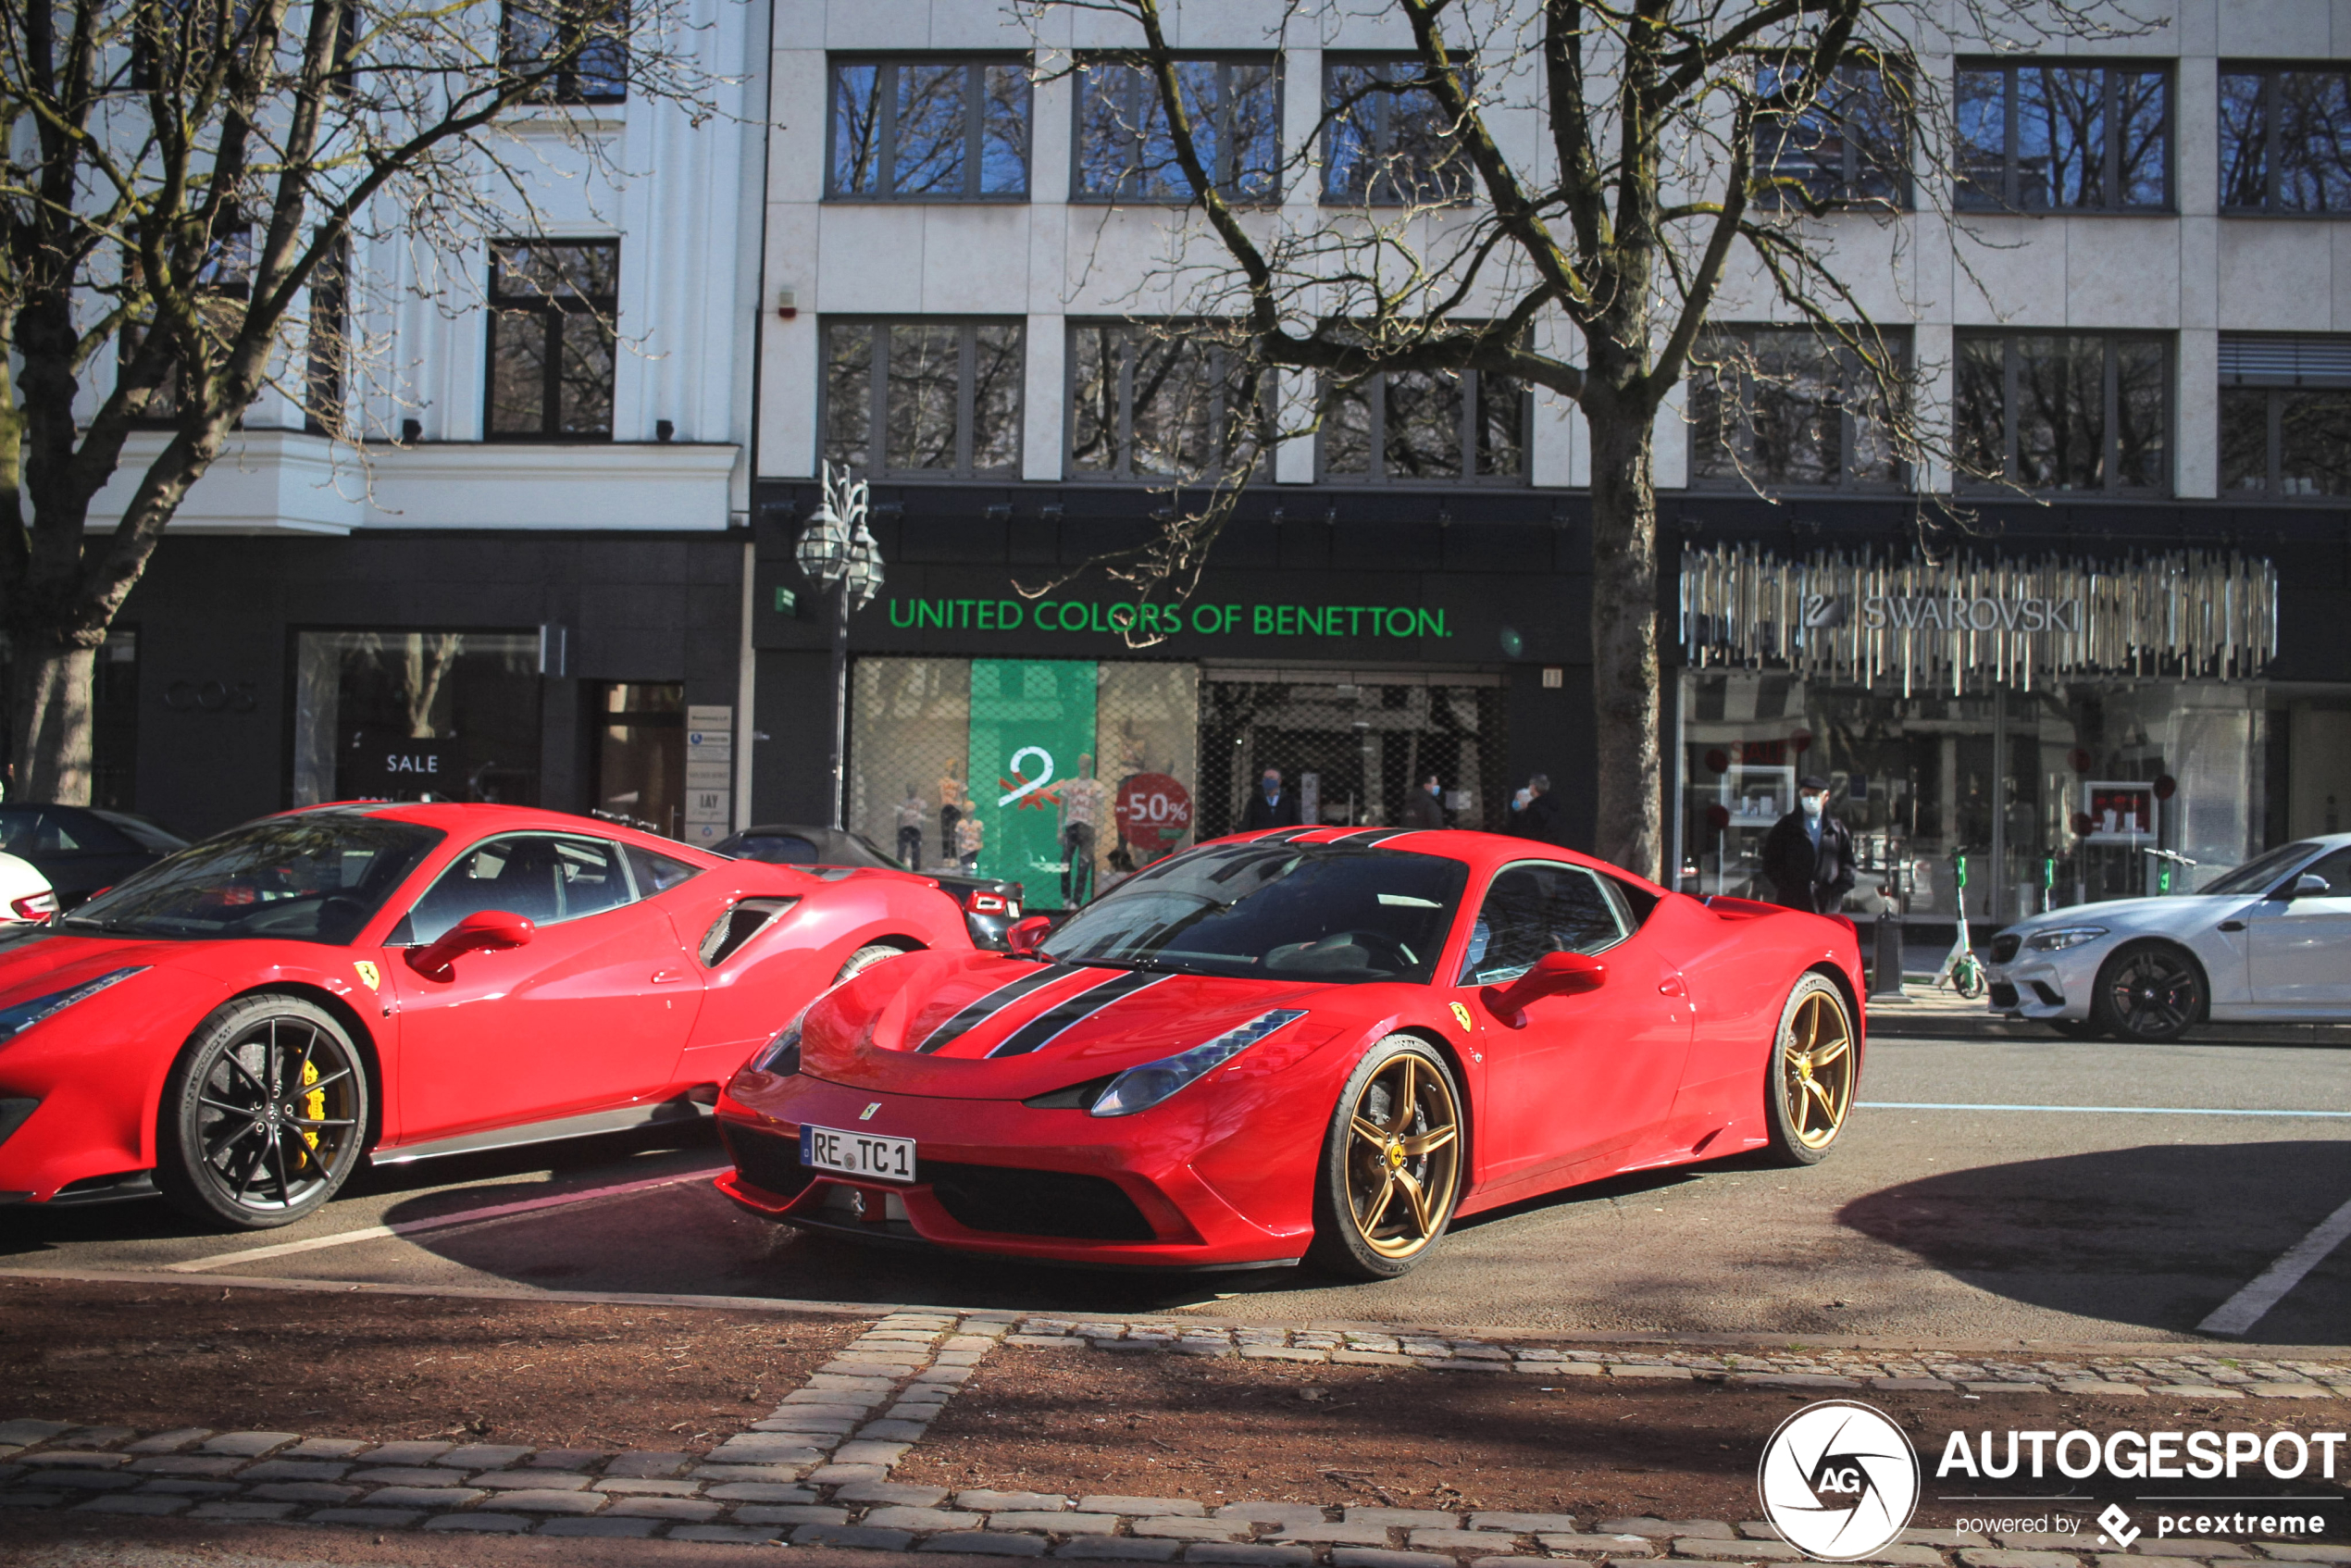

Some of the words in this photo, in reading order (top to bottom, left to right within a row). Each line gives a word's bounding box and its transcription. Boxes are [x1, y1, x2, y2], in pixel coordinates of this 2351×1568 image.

[889, 598, 1024, 629] UNITED
[1034, 602, 1182, 633] COLORS
[1192, 604, 1242, 633] OF
[1253, 604, 1452, 637] BENETTON.
[1863, 595, 2082, 631] SWAROVSKI
[387, 754, 438, 773] SALE
[814, 1132, 841, 1166] RE
